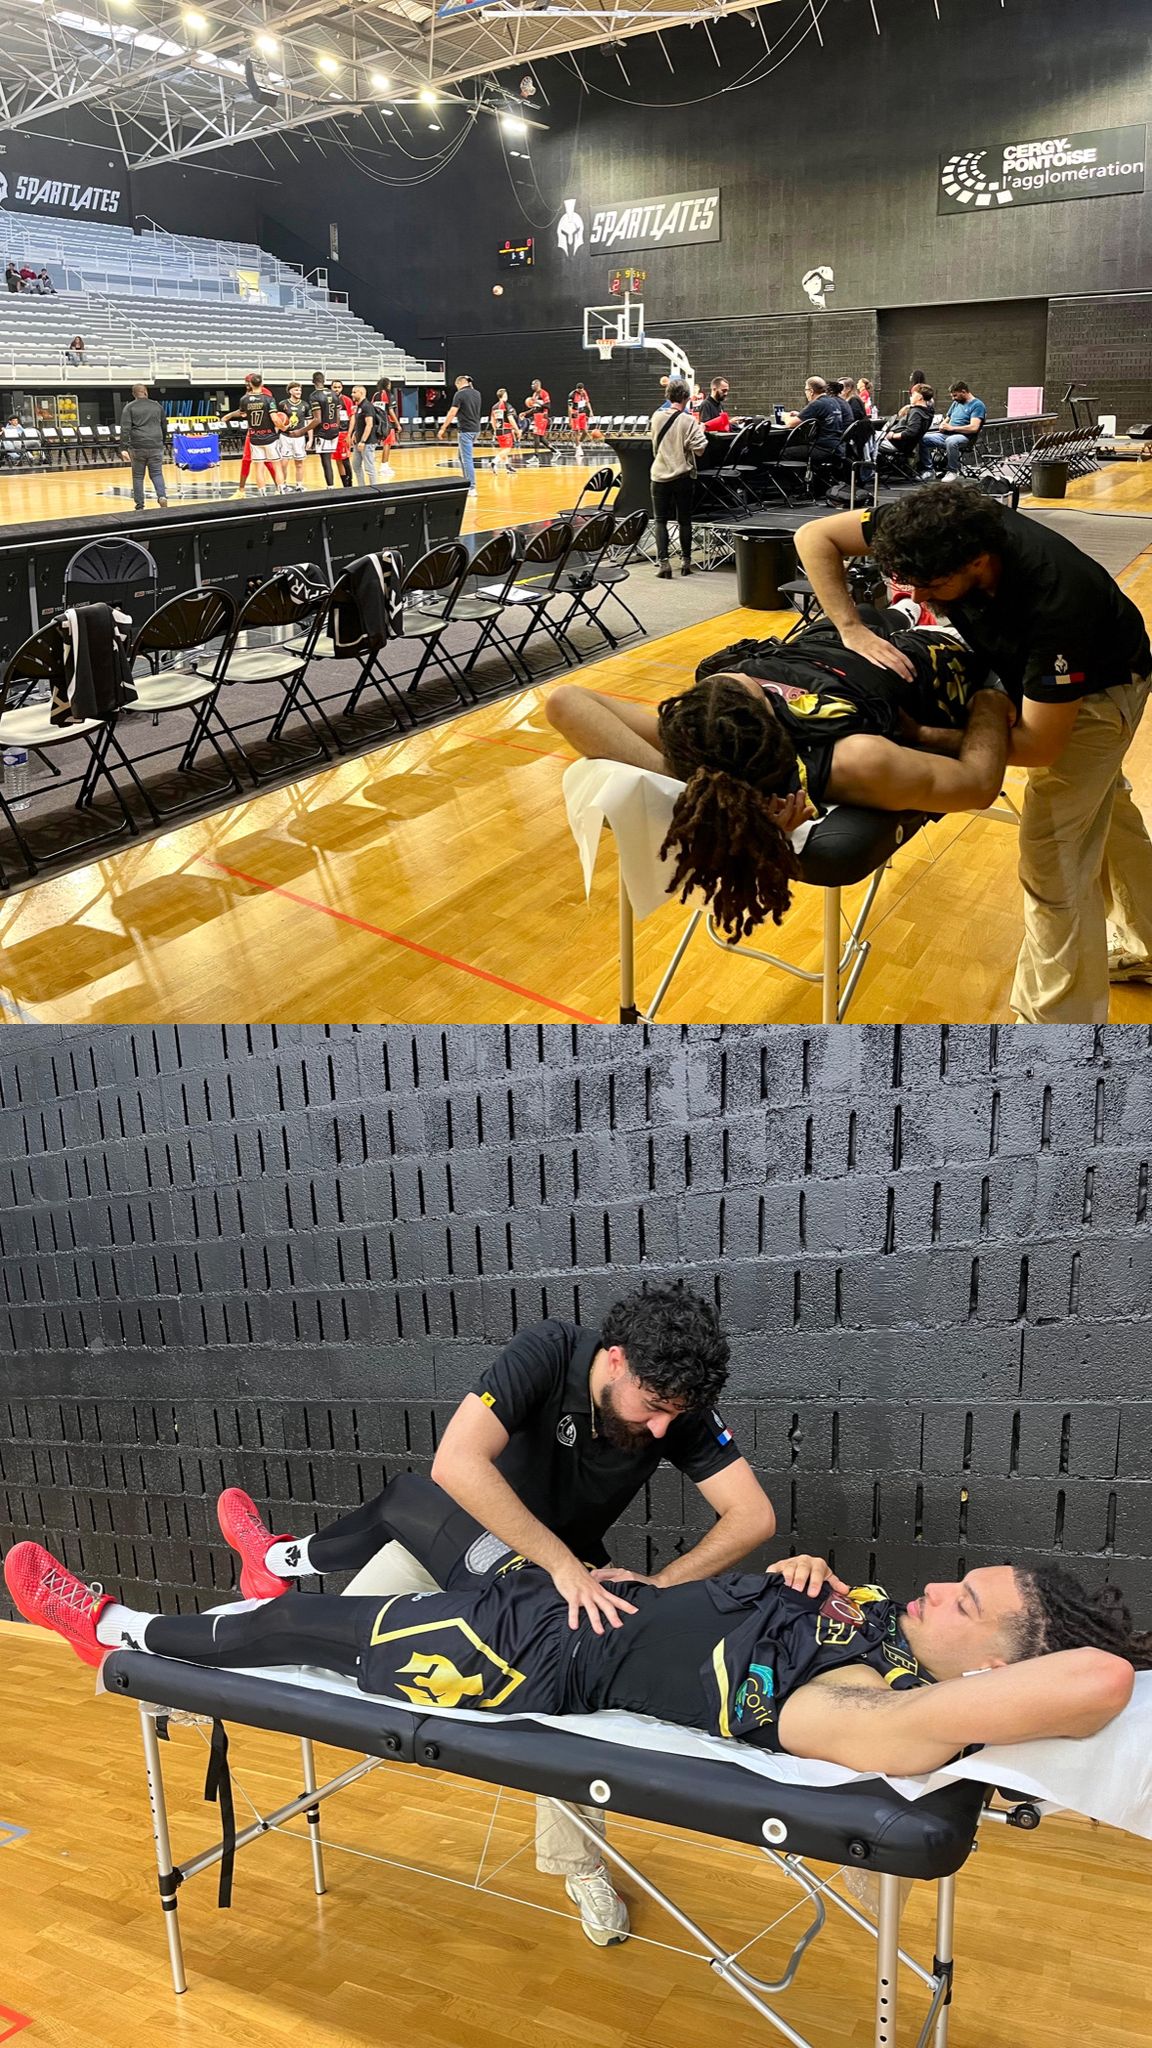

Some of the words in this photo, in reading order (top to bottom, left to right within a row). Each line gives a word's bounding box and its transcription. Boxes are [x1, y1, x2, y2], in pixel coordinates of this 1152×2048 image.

[1003, 137, 1072, 160] CERGY-
[1002, 161, 1144, 191] l'agglomération
[15, 175, 121, 213] SPARTIATES
[589, 196, 719, 246] SPARTIATES
[250, 409, 264, 427] 17
